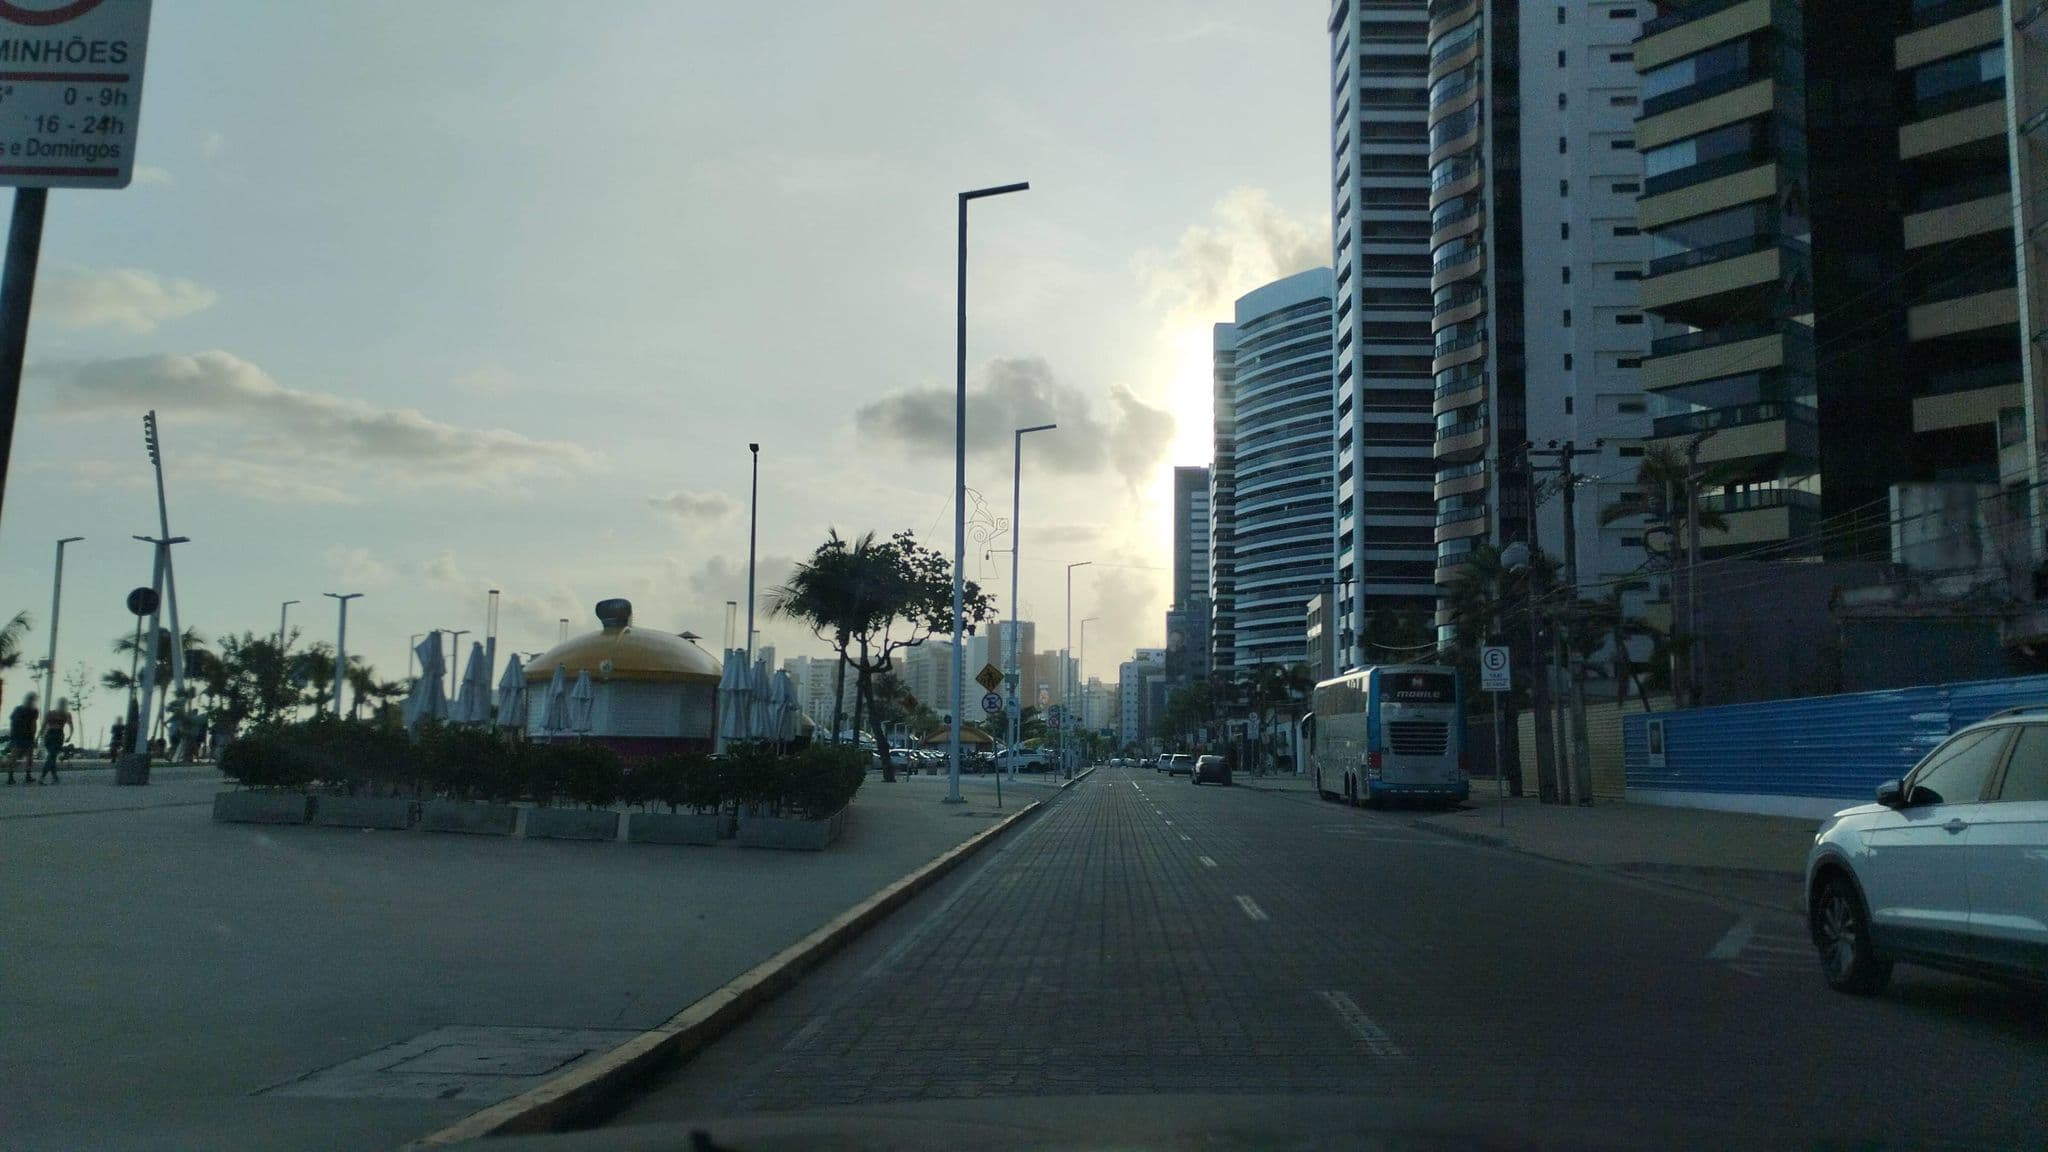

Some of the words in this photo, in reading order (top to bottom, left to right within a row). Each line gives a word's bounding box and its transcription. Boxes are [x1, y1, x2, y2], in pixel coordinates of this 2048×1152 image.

[64, 87, 77, 106] 0
[99, 87, 128, 106] 9h
[35, 115, 60, 134] 16
[83, 116, 124, 134] 24h
[11, 143, 21, 156] e
[26, 138, 120, 162] Domingos
[1491, 653, 1499, 666] E
